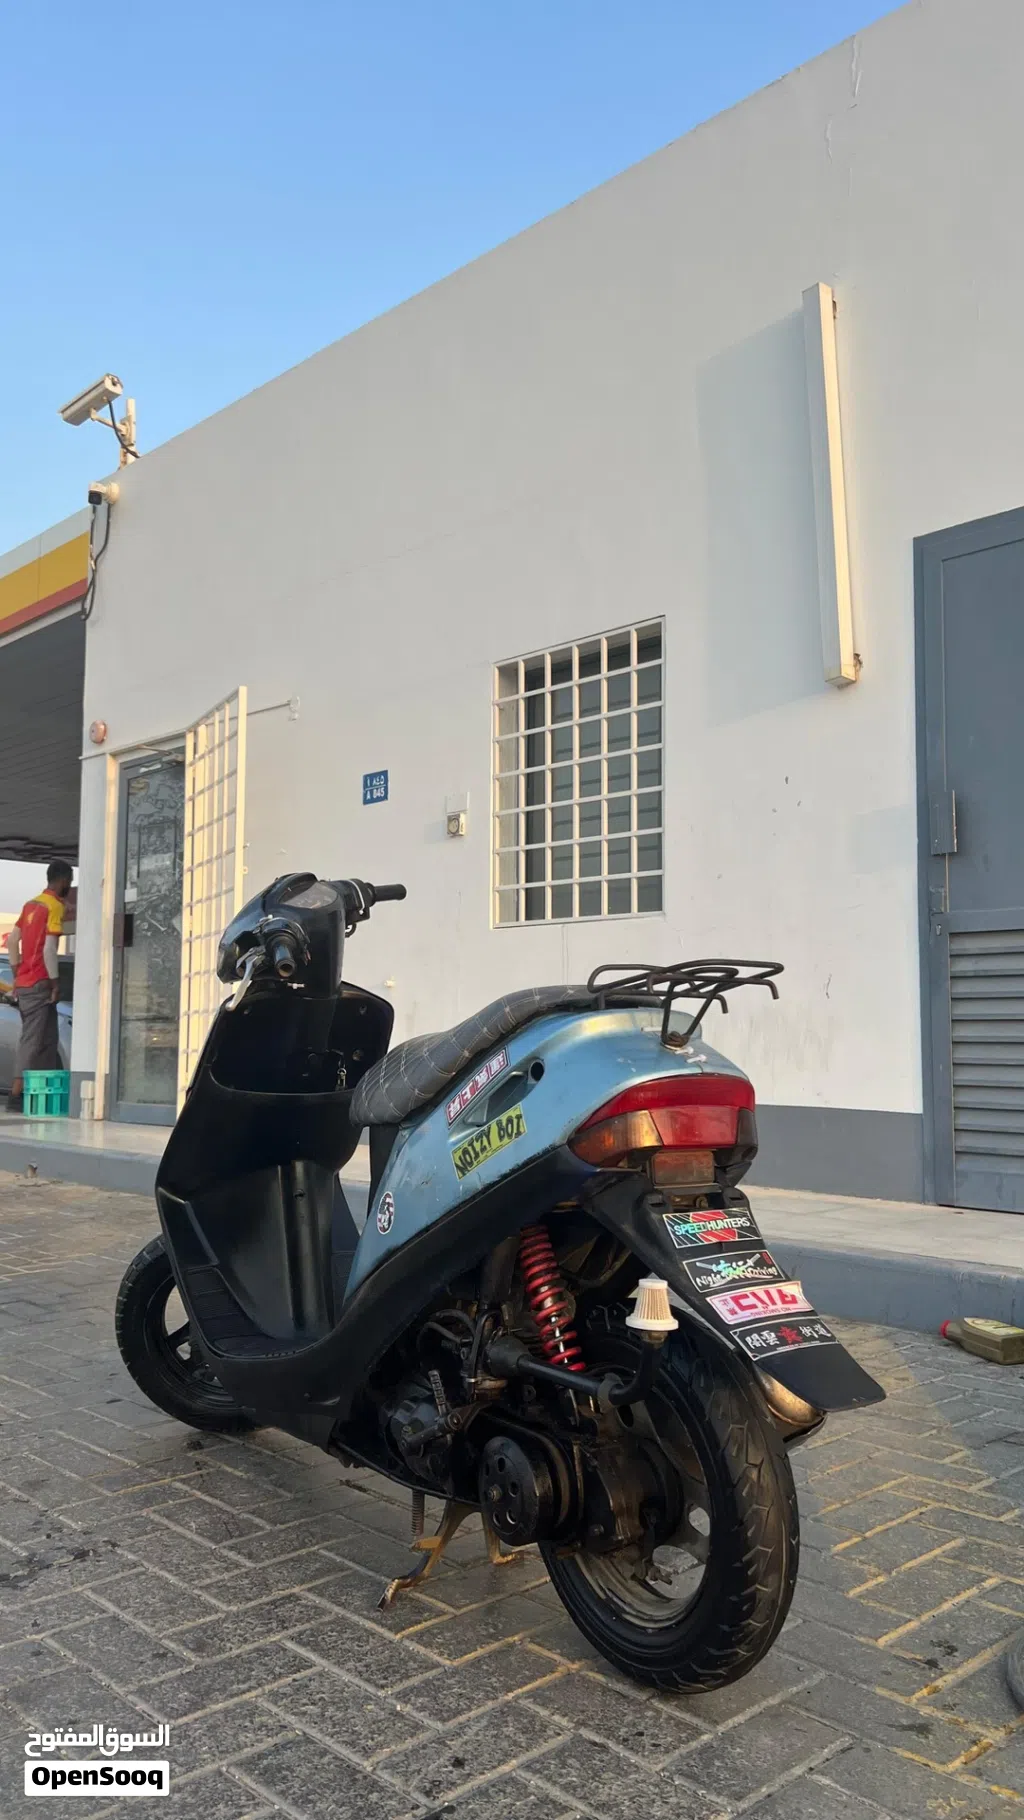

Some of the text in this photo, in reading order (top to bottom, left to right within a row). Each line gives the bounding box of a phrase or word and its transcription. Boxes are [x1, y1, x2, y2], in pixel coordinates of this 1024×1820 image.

[366, 790, 371, 800] A
[455, 1124, 492, 1176] NOIZY
[674, 1217, 750, 1235] SPEEDHUNTERS
[751, 1308, 781, 1317] SMOKING
